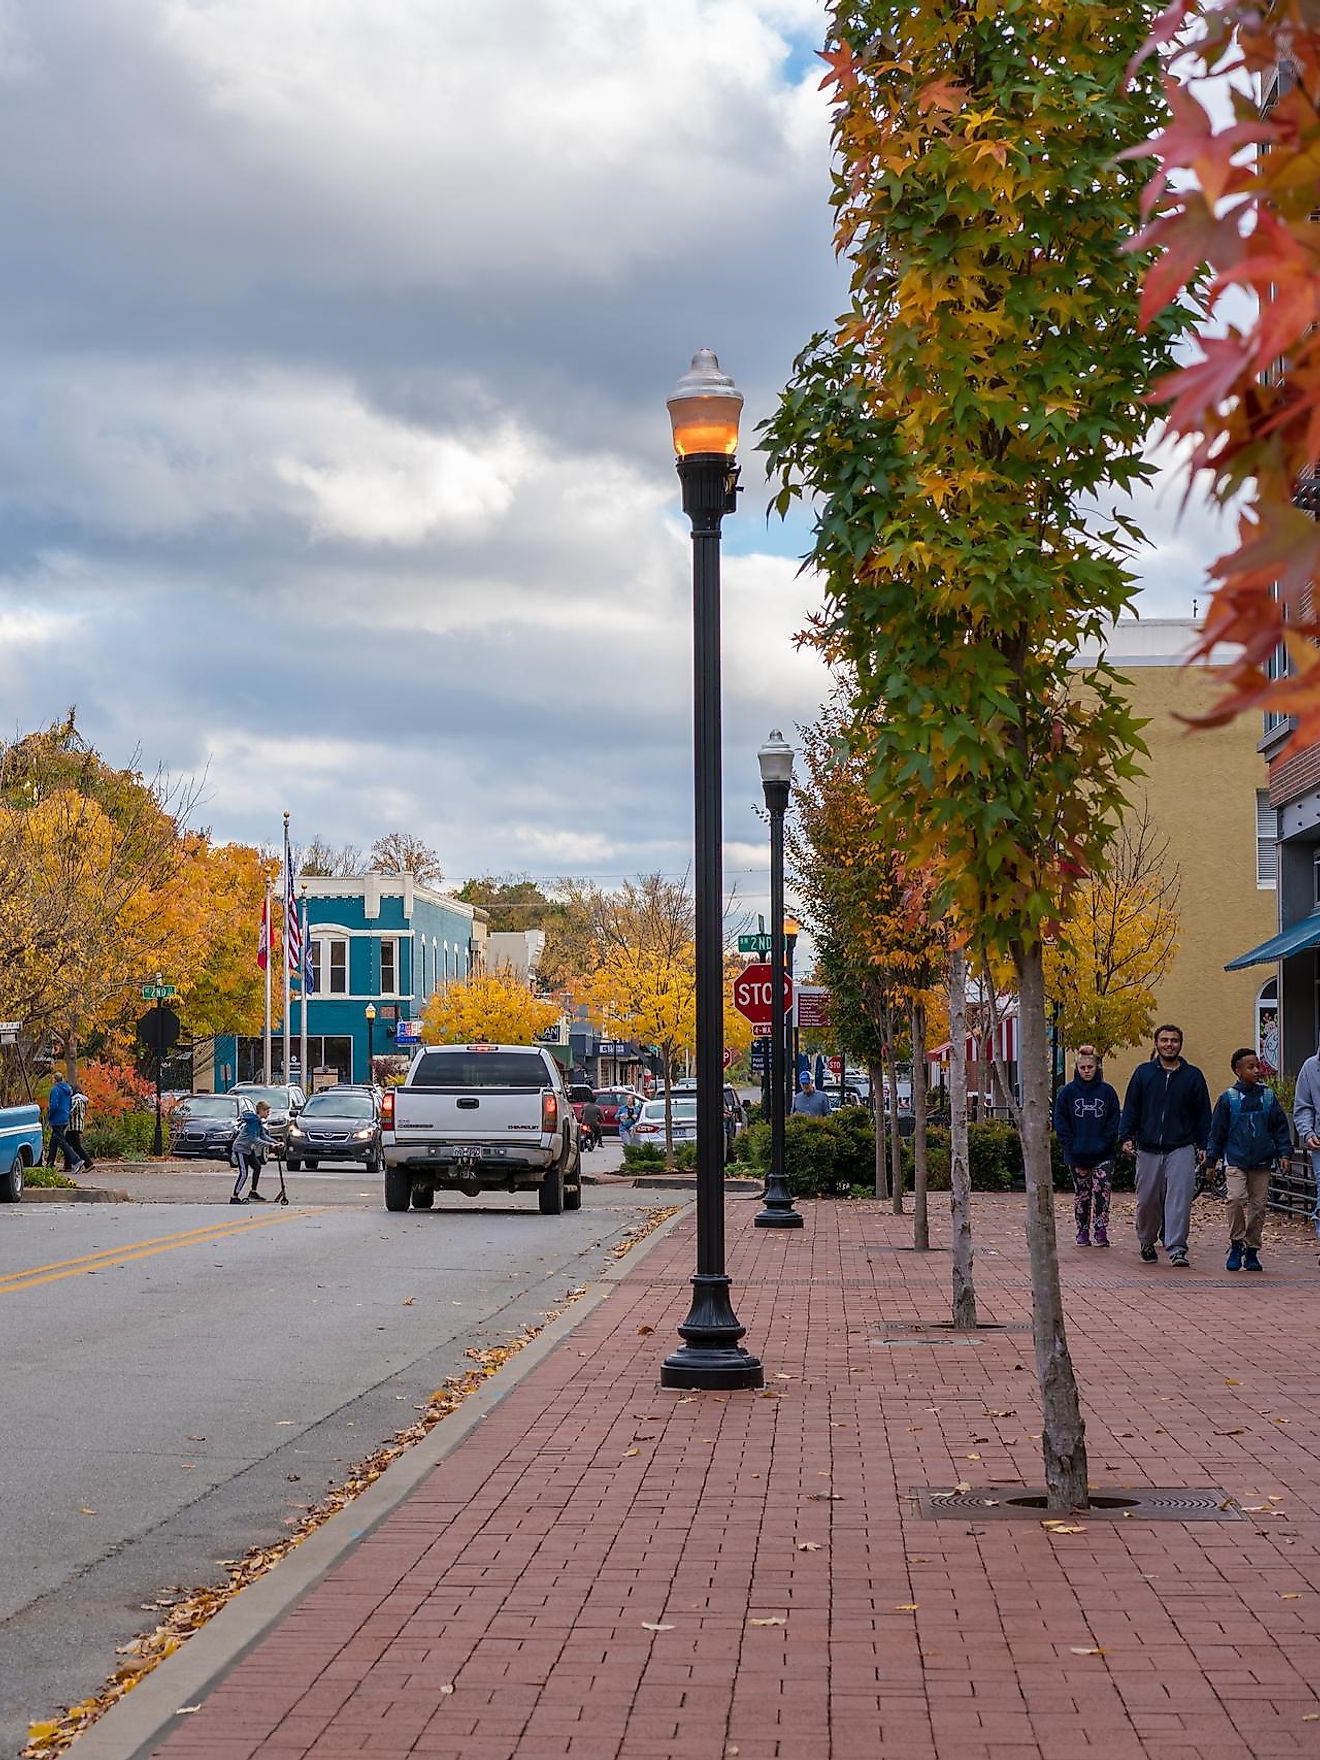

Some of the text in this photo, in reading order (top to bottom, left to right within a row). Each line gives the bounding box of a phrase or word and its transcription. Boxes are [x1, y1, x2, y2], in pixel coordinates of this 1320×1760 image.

[750, 936, 772, 950] 2ND
[753, 1026, 772, 1035] 4-WA
[829, 1061, 841, 1069] STO
